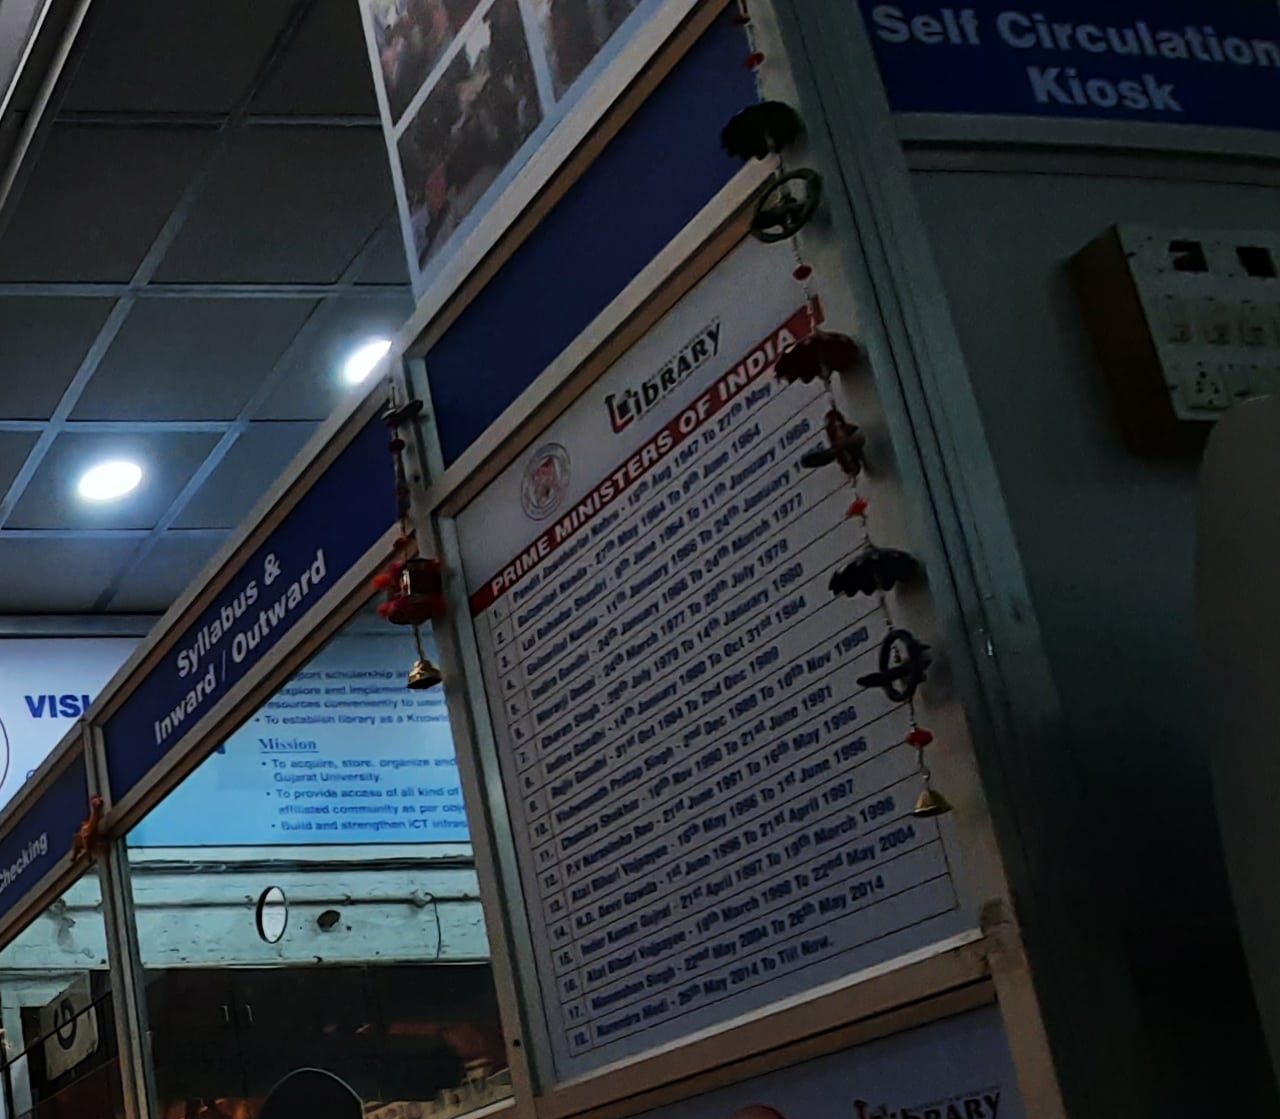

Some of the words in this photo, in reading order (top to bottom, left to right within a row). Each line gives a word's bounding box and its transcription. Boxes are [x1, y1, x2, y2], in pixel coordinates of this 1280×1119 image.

[872, 5, 982, 45] Self
[996, 10, 1280, 68] Circulation
[1026, 65, 1184, 112] Kiosk
[491, 536, 550, 595] PRIME
[554, 430, 672, 541] MINISTERS
[679, 394, 709, 433] OF
[718, 329, 794, 400] INDIA
[176, 580, 259, 678] Syllabus
[264, 553, 281, 586] &
[154, 664, 217, 745] Inward
[231, 548, 327, 663] Outward
[259, 738, 317, 750] Mission
[272, 759, 286, 768] To
[379, 759, 429, 770] organize
[274, 773, 317, 784] Gujarat
[277, 790, 290, 798] To
[294, 789, 338, 800] provide
[341, 790, 382, 798] access
[386, 788, 399, 797] of
[401, 788, 415, 797] all
[419, 788, 444, 797] kind
